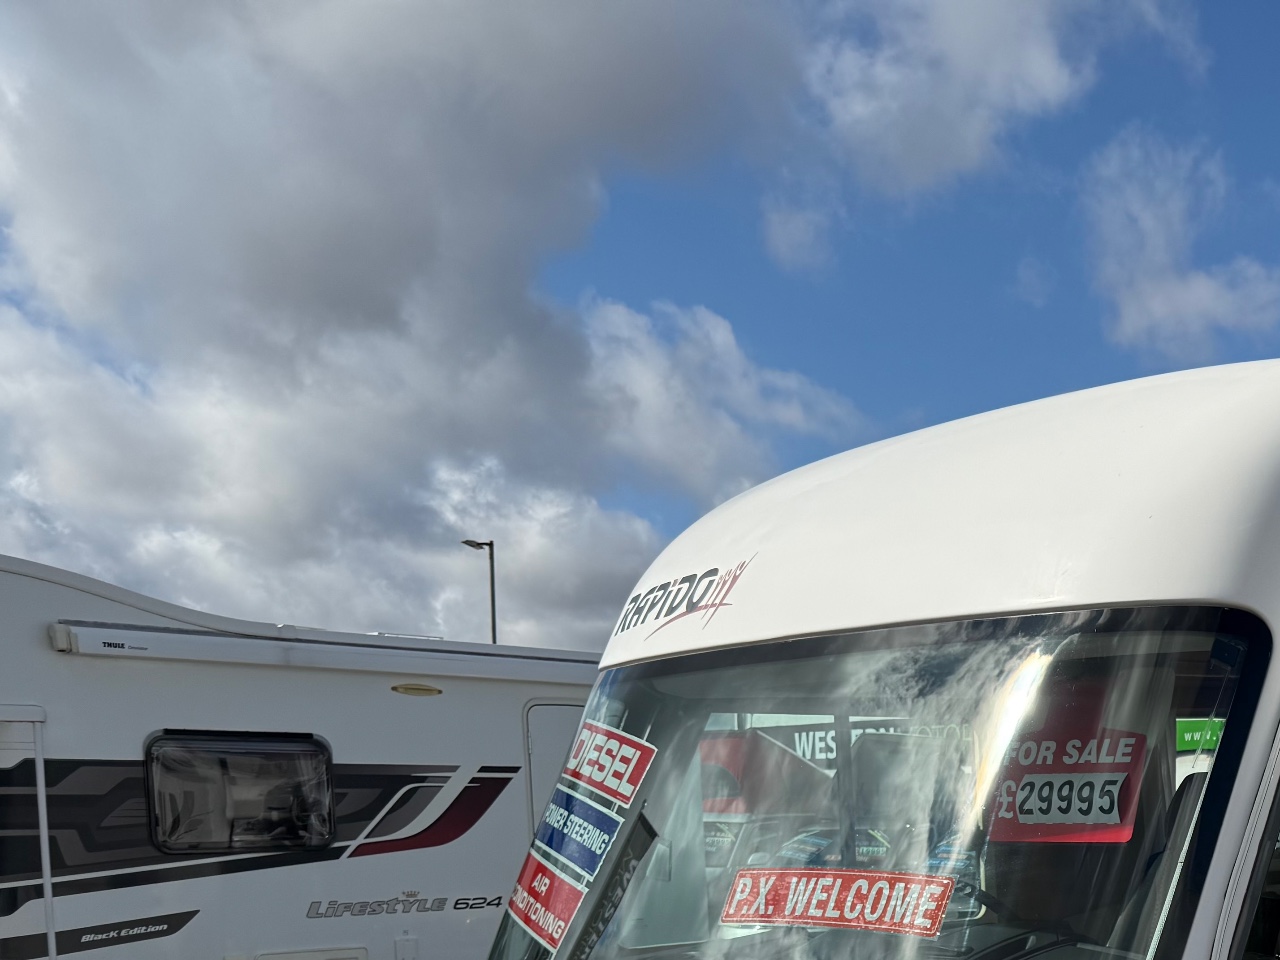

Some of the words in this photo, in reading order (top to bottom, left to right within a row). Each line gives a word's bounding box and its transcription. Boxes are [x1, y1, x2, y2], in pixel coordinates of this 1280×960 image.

[102, 641, 126, 649] THULE
[567, 730, 642, 797] DIESEL
[1003, 740, 1057, 766] FOR
[1062, 737, 1137, 764] SALE
[998, 778, 1119, 819] £29995
[565, 814, 610, 855] STEERING
[532, 873, 551, 896] AIR
[453, 896, 503, 910] 624
[785, 877, 945, 929] WELCOME
[120, 924, 168, 937] Edition
